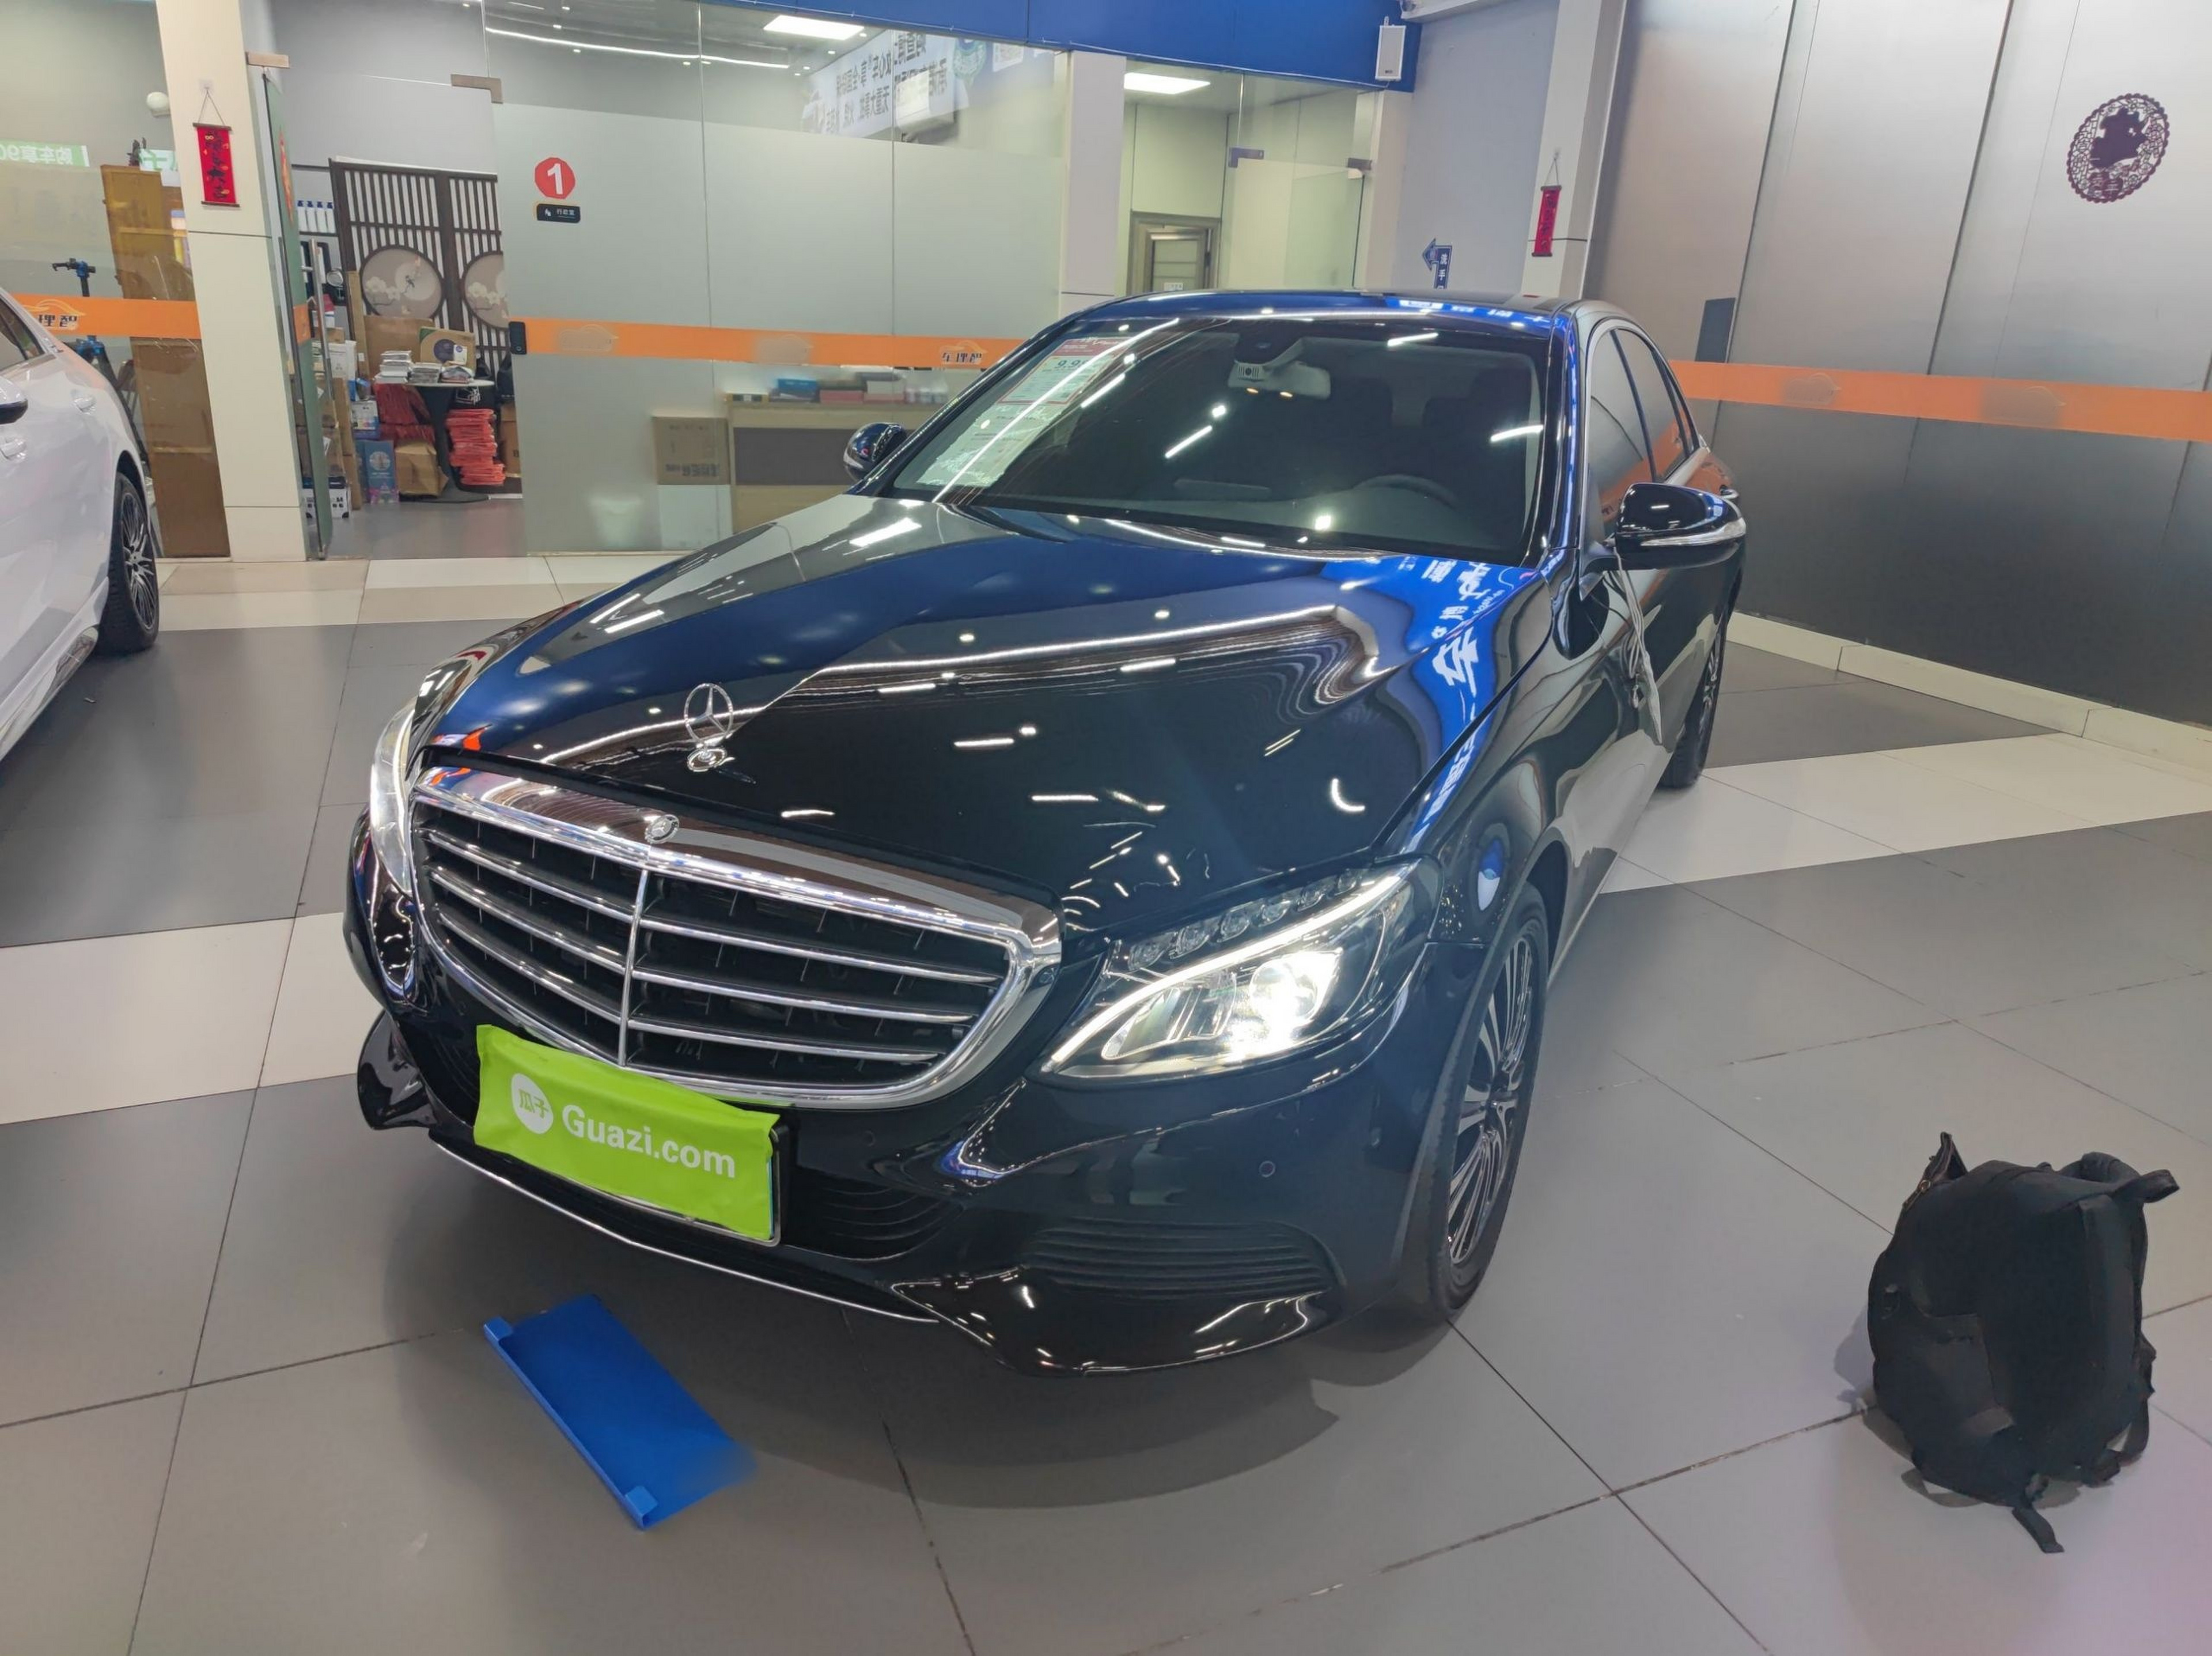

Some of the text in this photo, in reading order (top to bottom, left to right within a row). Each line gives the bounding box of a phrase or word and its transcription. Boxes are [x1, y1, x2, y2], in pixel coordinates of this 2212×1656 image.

[547, 163, 563, 194] 1
[37, 313, 78, 328] 理智
[518, 1091, 548, 1120] 瓜子
[562, 1105, 735, 1178] Guazi.com
